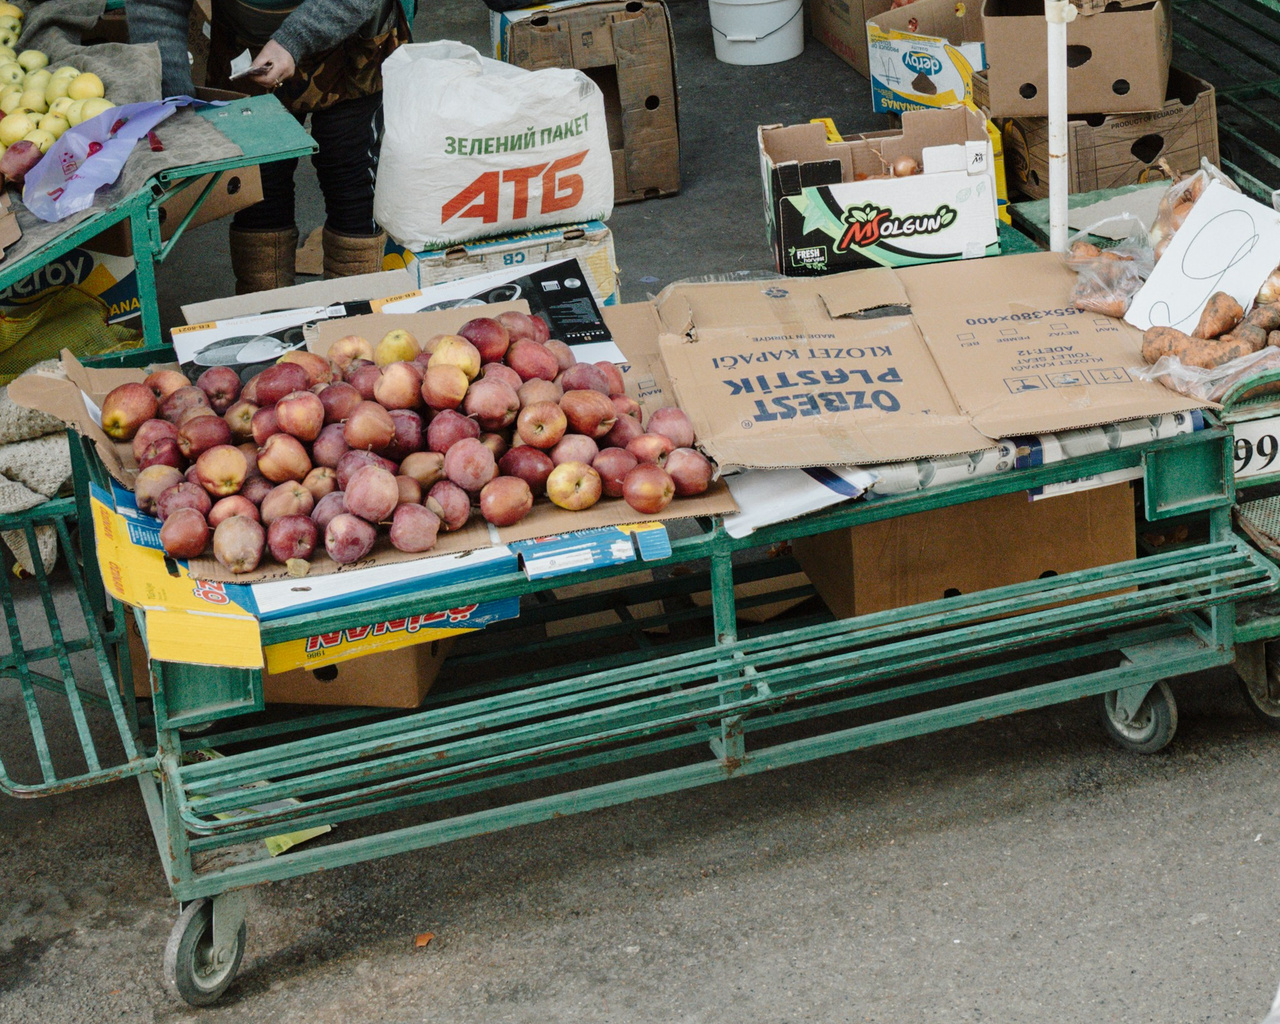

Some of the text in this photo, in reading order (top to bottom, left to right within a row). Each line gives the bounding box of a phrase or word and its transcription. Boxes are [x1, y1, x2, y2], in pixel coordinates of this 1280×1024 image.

[904, 50, 940, 76] derby
[1111, 118, 1142, 130] PRODUCT
[1152, 107, 1185, 121] ECUADOR
[444, 112, 589, 156] ЗЕЛЕНИЙ ПАКЕТ
[441, 148, 590, 225] АТБ
[503, 251, 526, 266] CB
[797, 248, 820, 258] FRESH
[803, 255, 825, 264] harvest
[712, 345, 893, 371] KLOZET KAPAĞI
[1016, 351, 1092, 365] TOILET SEAT
[1053, 357, 1104, 367] KLOZET
